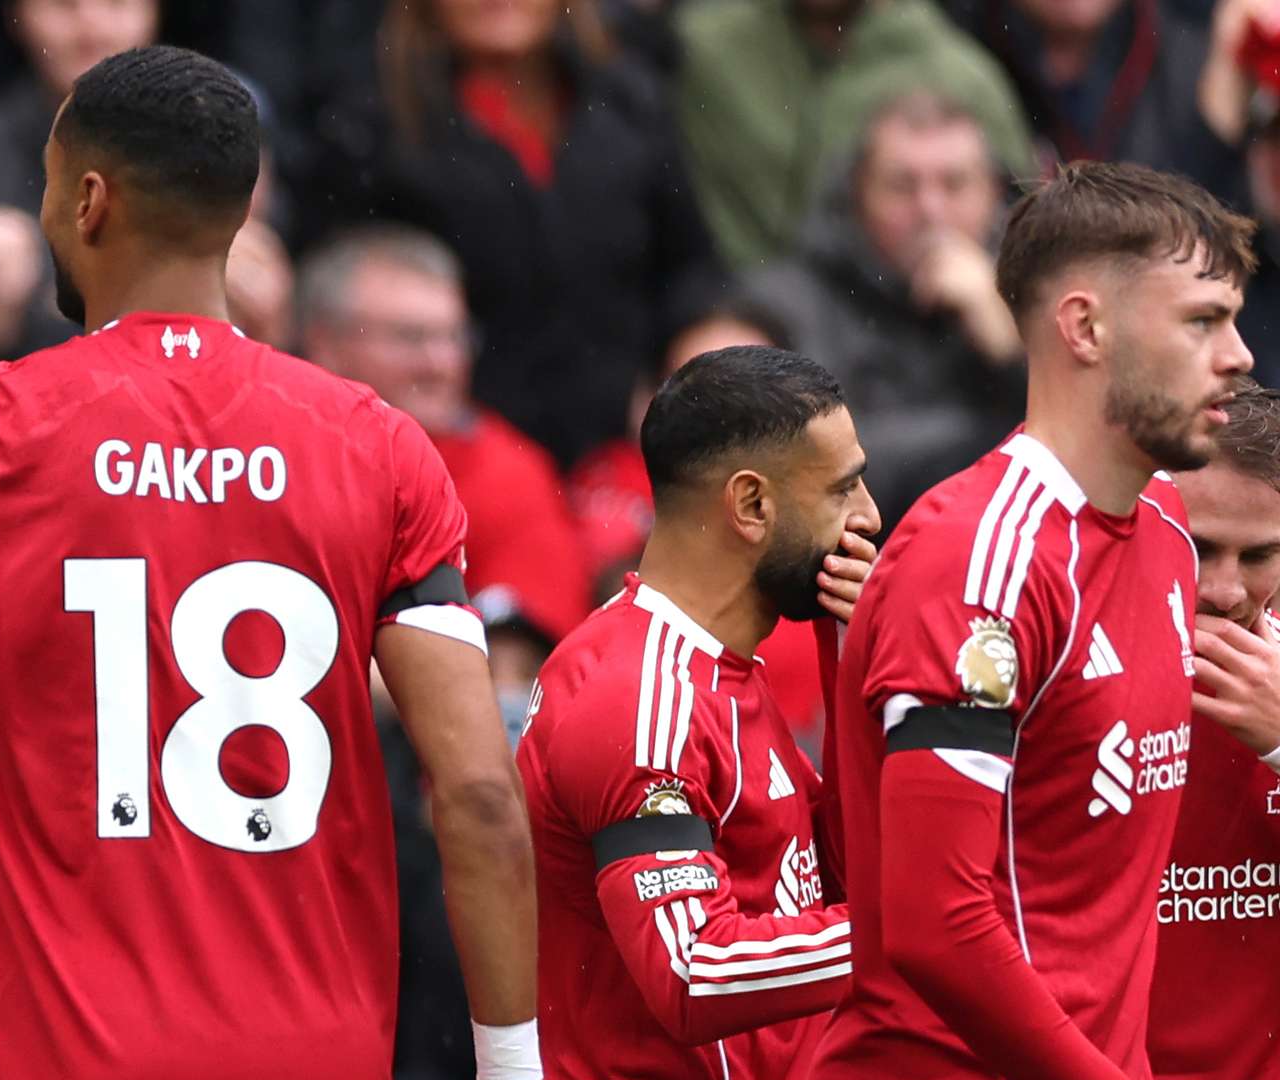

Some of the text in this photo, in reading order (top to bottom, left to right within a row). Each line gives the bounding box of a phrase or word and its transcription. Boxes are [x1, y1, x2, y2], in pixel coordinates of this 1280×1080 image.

[93, 438, 288, 504] GAKPO
[62, 557, 342, 855] 18
[634, 870, 661, 886] No
[1159, 858, 1280, 893] standa
[1156, 890, 1280, 924] charter
